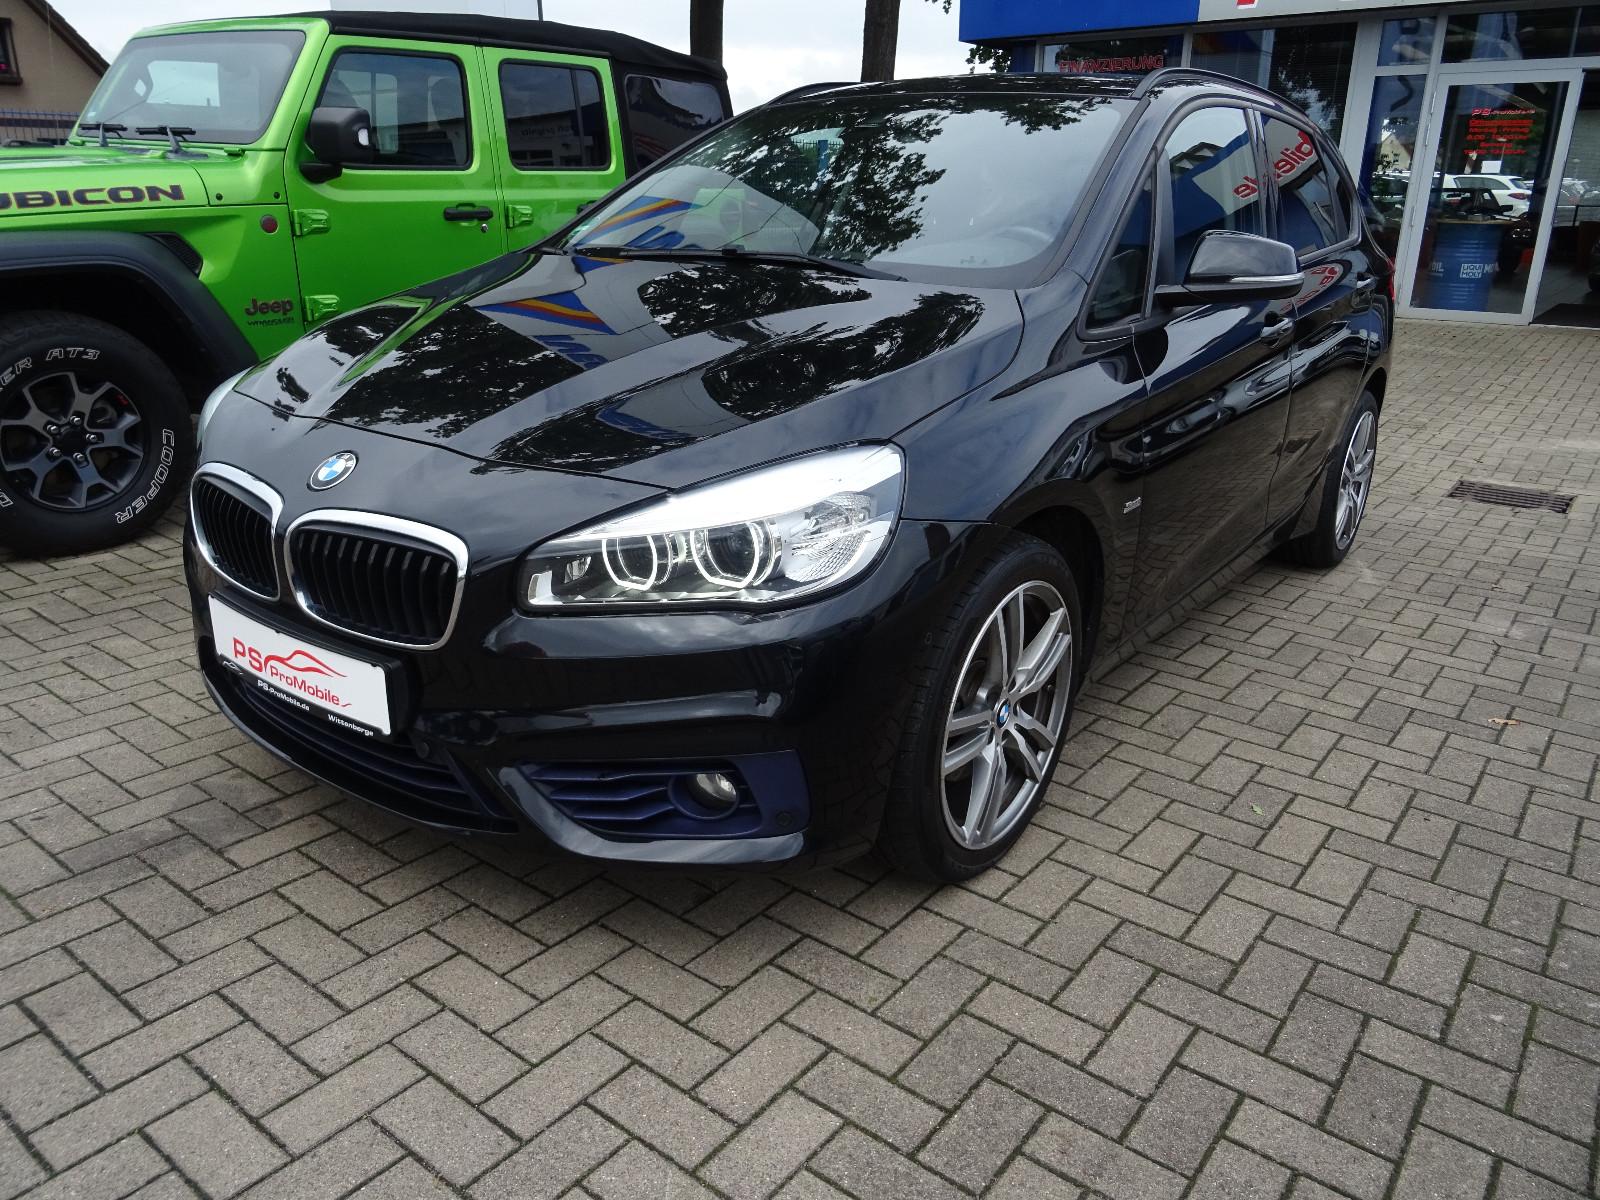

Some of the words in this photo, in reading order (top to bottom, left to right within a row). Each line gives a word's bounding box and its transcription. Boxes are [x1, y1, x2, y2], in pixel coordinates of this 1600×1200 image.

[1058, 55, 1164, 75] FINANZIERUNG
[0, 184, 185, 210] BICON
[1462, 264, 1484, 272] LIQUI
[244, 297, 294, 316] Jeep
[45, 347, 100, 361] AT3
[115, 428, 175, 524] COOPER
[232, 637, 264, 674] PS
[269, 664, 341, 706] ProMobile
[327, 713, 374, 737] Wittenberge
